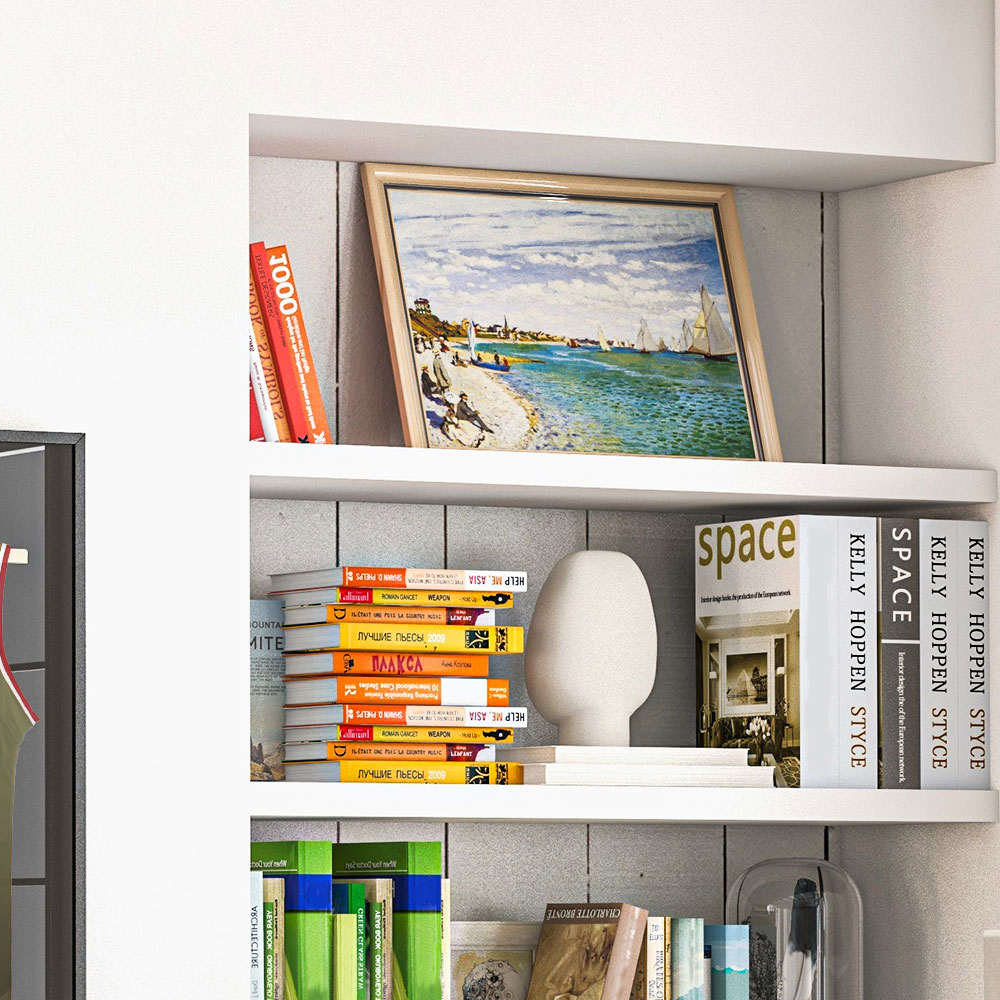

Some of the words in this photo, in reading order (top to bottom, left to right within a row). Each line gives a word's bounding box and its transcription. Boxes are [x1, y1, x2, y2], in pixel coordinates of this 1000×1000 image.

[698, 518, 796, 580] space
[850, 533, 866, 596] KELLY
[892, 527, 912, 623] SPACE
[931, 536, 947, 598] KELLY
[968, 537, 985, 600] KELLY
[356, 572, 376, 581] PHELPS
[469, 575, 487, 585] ASIA
[505, 576, 525, 586] HELP
[427, 594, 451, 602] WEAPON
[250, 620, 284, 629] OUNTA
[357, 631, 392, 642] ЛУЧШИЕ
[395, 632, 424, 642] ПЬЕСЫ
[427, 633, 446, 643] 2009
[850, 610, 867, 692] HOPPEN
[931, 612, 948, 694] HOPPEN
[969, 612, 985, 694] HOPPEN
[372, 655, 423, 674] ПЛАКСА
[897, 651, 906, 675] Interior
[896, 675, 906, 696] design
[897, 696, 906, 707] the
[356, 709, 377, 719] PHELPS
[469, 711, 487, 721] ASIA
[505, 711, 525, 722] HELP
[897, 715, 906, 726] the
[850, 706, 867, 768] STYCE
[896, 726, 906, 756] European
[931, 707, 948, 769] STYCE
[969, 708, 986, 770] STYCE
[357, 769, 392, 779] ЛУЧШИЕ
[396, 770, 425, 779] ПЬЕСЫ
[428, 770, 446, 779] 2009
[576, 908, 621, 919] CHARLOTTE
[655, 950, 663, 988] PIRATES
